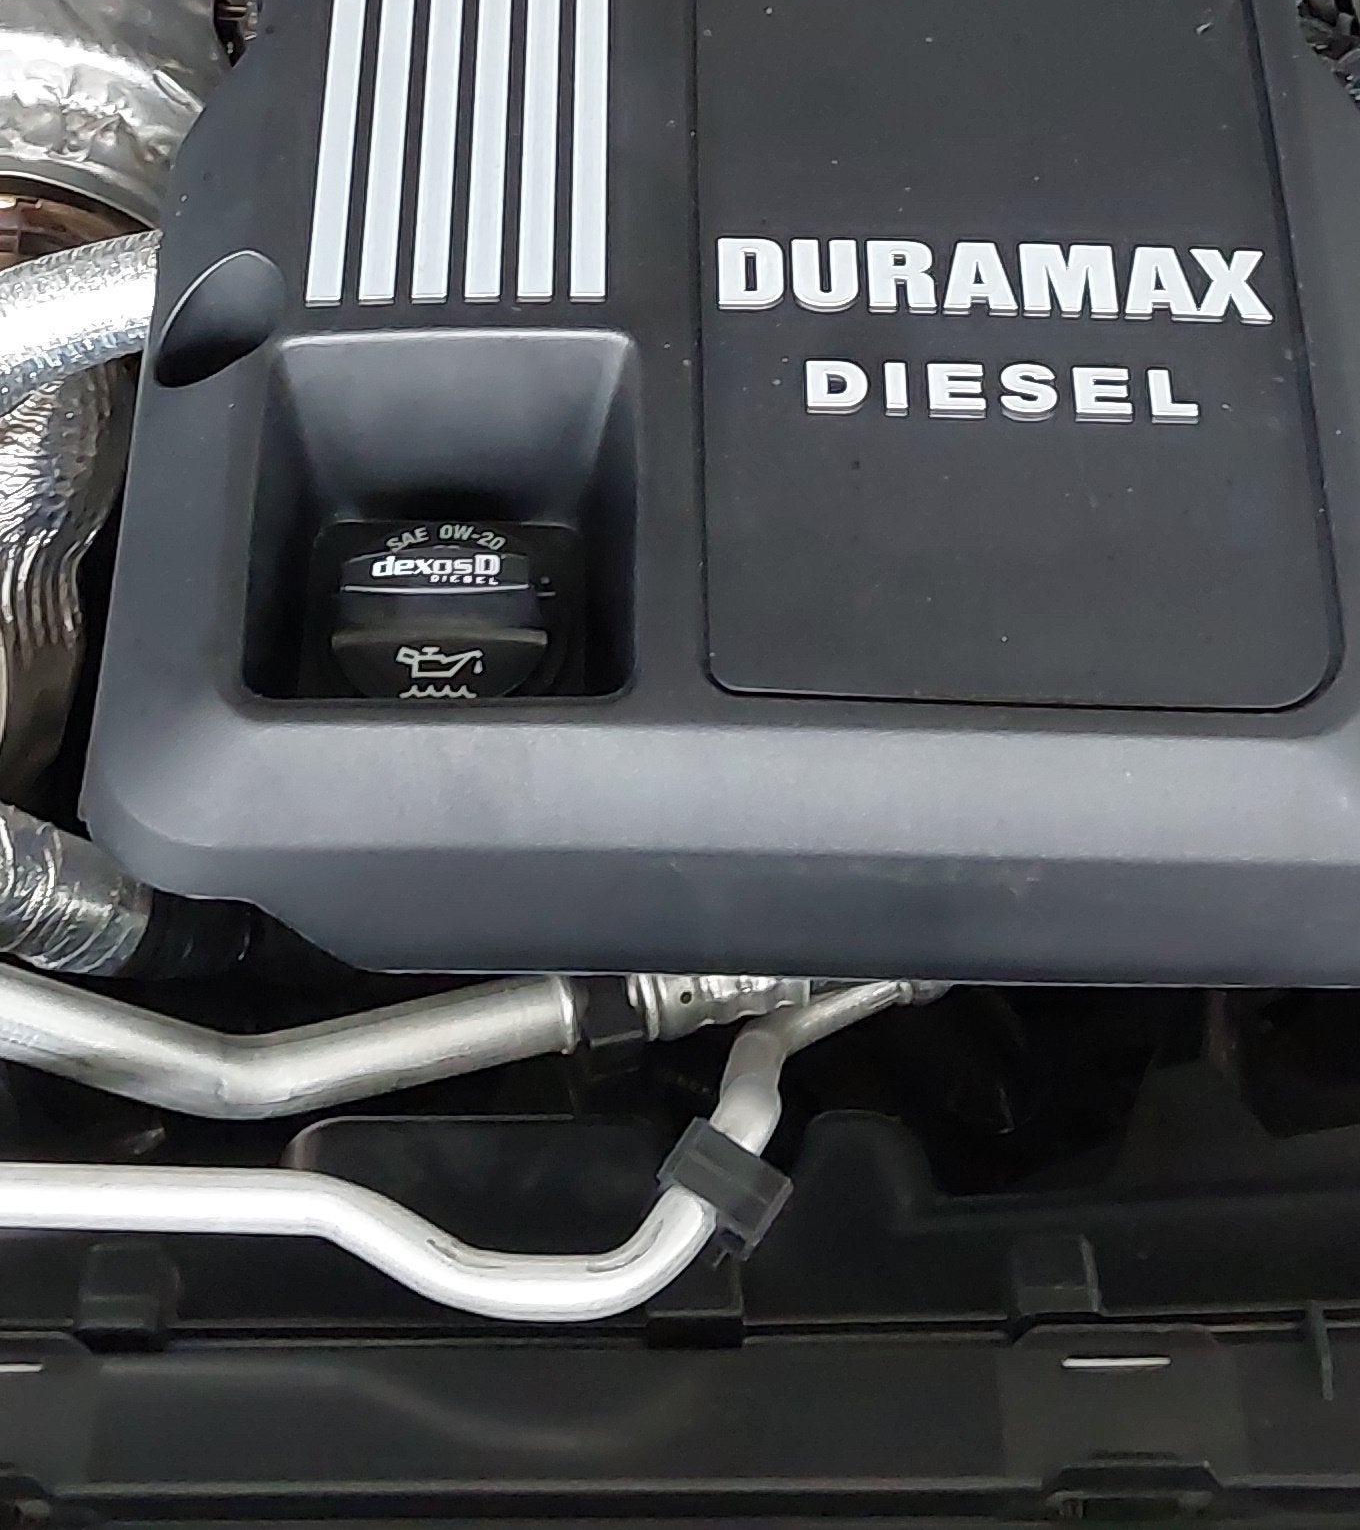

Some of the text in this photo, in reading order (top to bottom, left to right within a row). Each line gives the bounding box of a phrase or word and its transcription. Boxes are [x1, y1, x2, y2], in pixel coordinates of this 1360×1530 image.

[716, 237, 1274, 325] DURAMAX
[804, 358, 1202, 424] DIESEL
[386, 524, 507, 552] SAE 0W-20
